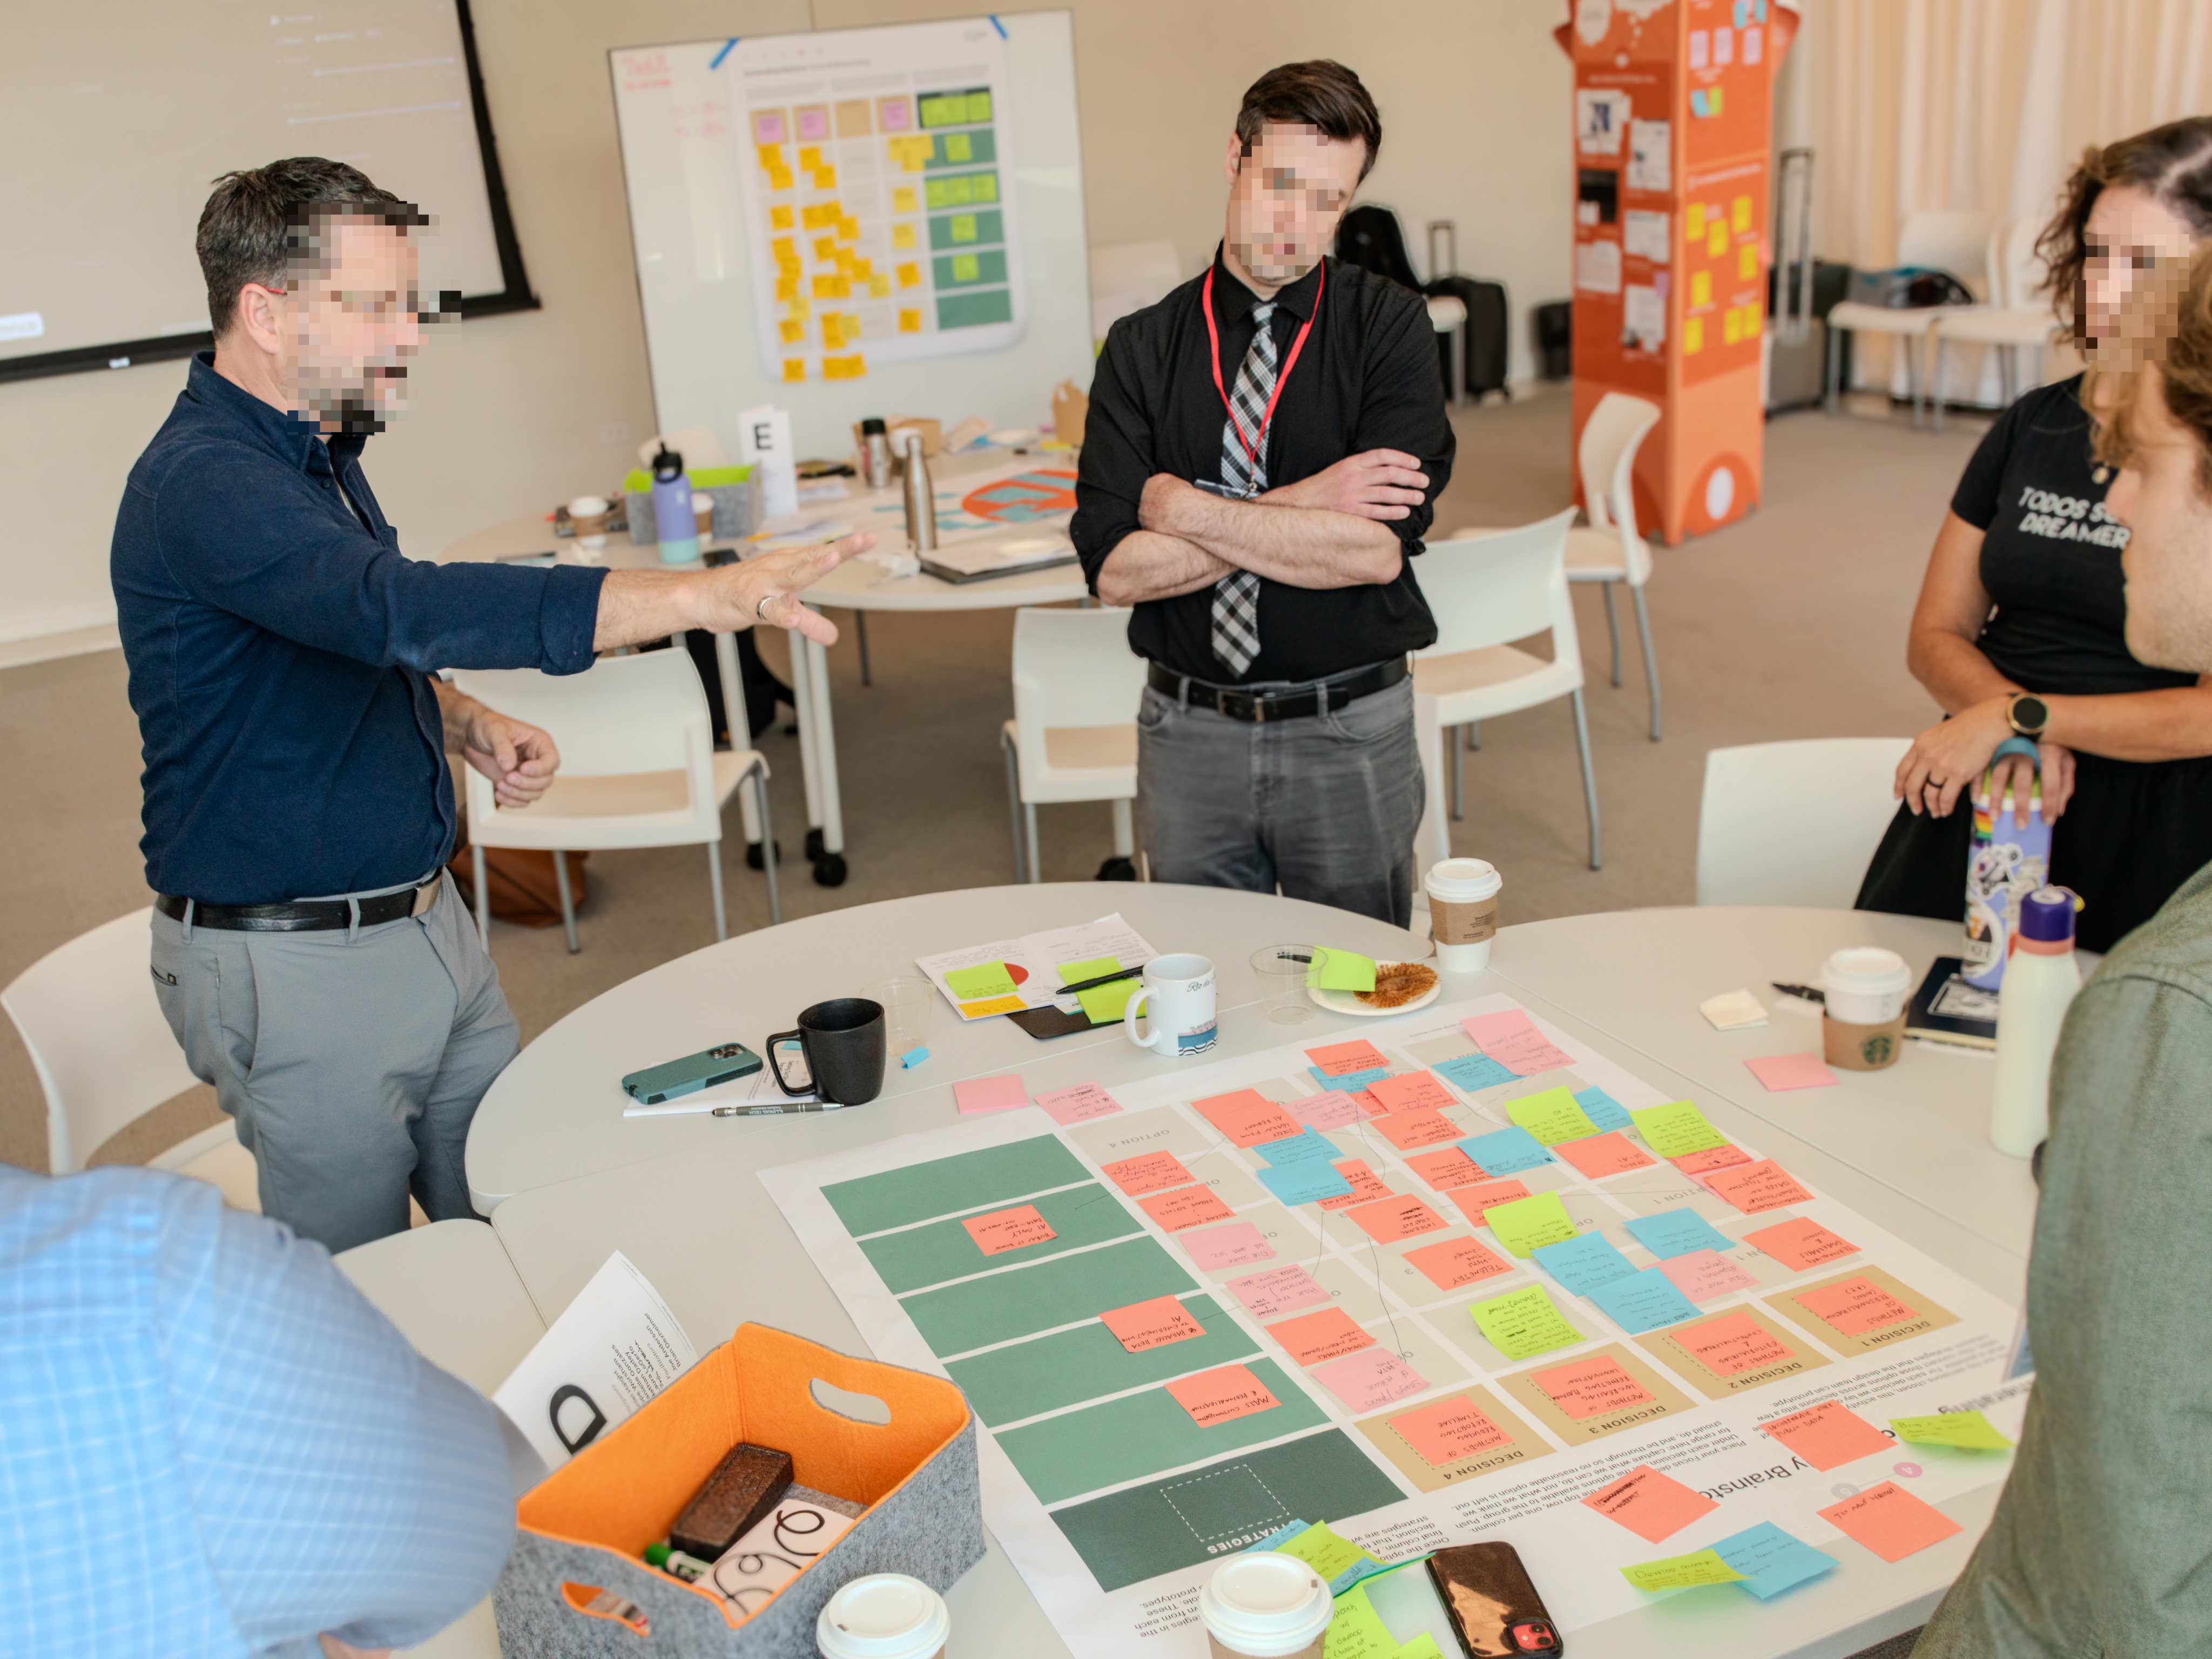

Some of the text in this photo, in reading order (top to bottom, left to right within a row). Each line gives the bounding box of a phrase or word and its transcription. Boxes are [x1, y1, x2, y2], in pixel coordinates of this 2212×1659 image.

[754, 423, 772, 449] E
[2018, 486, 2089, 520] TODOS
[1186, 979, 1210, 992] Rio de
[1120, 1129, 1170, 1145] OPTION
[1011, 1228, 1033, 1237] ONLY
[1452, 1264, 1502, 1284] TELEMETRY
[1866, 1306, 1905, 1324] METHODS
[643, 1312, 682, 1367] Brian Dexheimer
[1131, 1330, 1185, 1348] PARALLEL BETA
[1870, 1320, 1931, 1344] DECISION
[645, 1325, 677, 1372] Joe Anderson
[1748, 1348, 1785, 1364] METHODS
[627, 1345, 649, 1374] LoGerfo
[646, 1342, 671, 1379] Facilitators
[1896, 1359, 1914, 1367] that
[610, 1344, 650, 1399] anielle Gonzales
[624, 1351, 656, 1397] athan Dadey
[1567, 1368, 1618, 1385] INNOVATION
[1739, 1361, 1802, 1385] DECISION
[1852, 1368, 1880, 1381] design
[1898, 1364, 1923, 1375] those
[1905, 1371, 1927, 1382] each
[611, 1357, 646, 1404] ope Worsham
[612, 1368, 632, 1394] Haight
[1830, 1378, 1853, 1389] team
[1866, 1371, 1898, 1386] options
[1870, 1378, 1906, 1393] decision
[1838, 1383, 1866, 1394] across
[1845, 1379, 1927, 1410] chosen, this activity
[1245, 1395, 1269, 1408] MASS
[1606, 1393, 1643, 1407] METHODS
[1769, 1390, 1813, 1409] prototype.
[1797, 1392, 1837, 1408] decisions
[1843, 1393, 1857, 1402] lay
[1601, 1405, 1667, 1429] DECISION
[1757, 1413, 1772, 1421] few
[1781, 1405, 1797, 1414] into
[549, 1383, 607, 1454] D
[1437, 1411, 1480, 1427] TIMELINE
[1456, 1425, 1495, 1441] REDUCING
[1675, 1429, 1691, 1440] do,
[1692, 1420, 1722, 1434] should
[1717, 1427, 1731, 1435] for
[1658, 1437, 1675, 1445] and
[1689, 1430, 1716, 1442] range
[1710, 1433, 1738, 1446] Under
[1446, 1434, 1501, 1457] METHODS OF
[1666, 1440, 1689, 1452] here:
[1688, 1442, 1710, 1453] each
[1604, 1445, 1645, 1462] thorough
[1631, 1447, 1665, 1463] capture
[1645, 1449, 1687, 1467] decision,
[1456, 1450, 1523, 1475] DECISION
[1607, 1460, 1630, 1471] what
[1528, 1467, 1579, 1487] reasonable
[1574, 1472, 1592, 1480] can
[1580, 1472, 1614, 1488] options
[1615, 1468, 1631, 1477] the
[1468, 1440, 1746, 1534] Place your Focus top row, one per column.
[1542, 1483, 1558, 1492] not
[1557, 1476, 1574, 1487] do,
[1839, 1465, 1913, 1496] 4 5
[1498, 1482, 1528, 1497] option
[1518, 1488, 1541, 1500] what
[1540, 1485, 1580, 1502] available
[1451, 1502, 1470, 1512] out.
[1471, 1496, 1488, 1506] left
[1477, 1501, 1502, 1513] think
[1511, 1502, 1528, 1512] the
[1480, 1506, 1510, 1520] group.
[1381, 1514, 1428, 1534] strategies
[1454, 1518, 1480, 1529] Push
[1372, 1521, 1435, 1545] decision, that
[1421, 1529, 1443, 1540] final
[1382, 1536, 1420, 1552] column.
[1405, 1536, 1449, 1554] Once the
[1635, 1566, 1676, 1579] Develop
[1138, 1584, 1197, 1609] prototypes.
[1145, 1603, 1177, 1617] These
[1134, 1610, 1186, 1630] from each
[1139, 1628, 1158, 1638] the
[1336, 1629, 1363, 1644] develop
